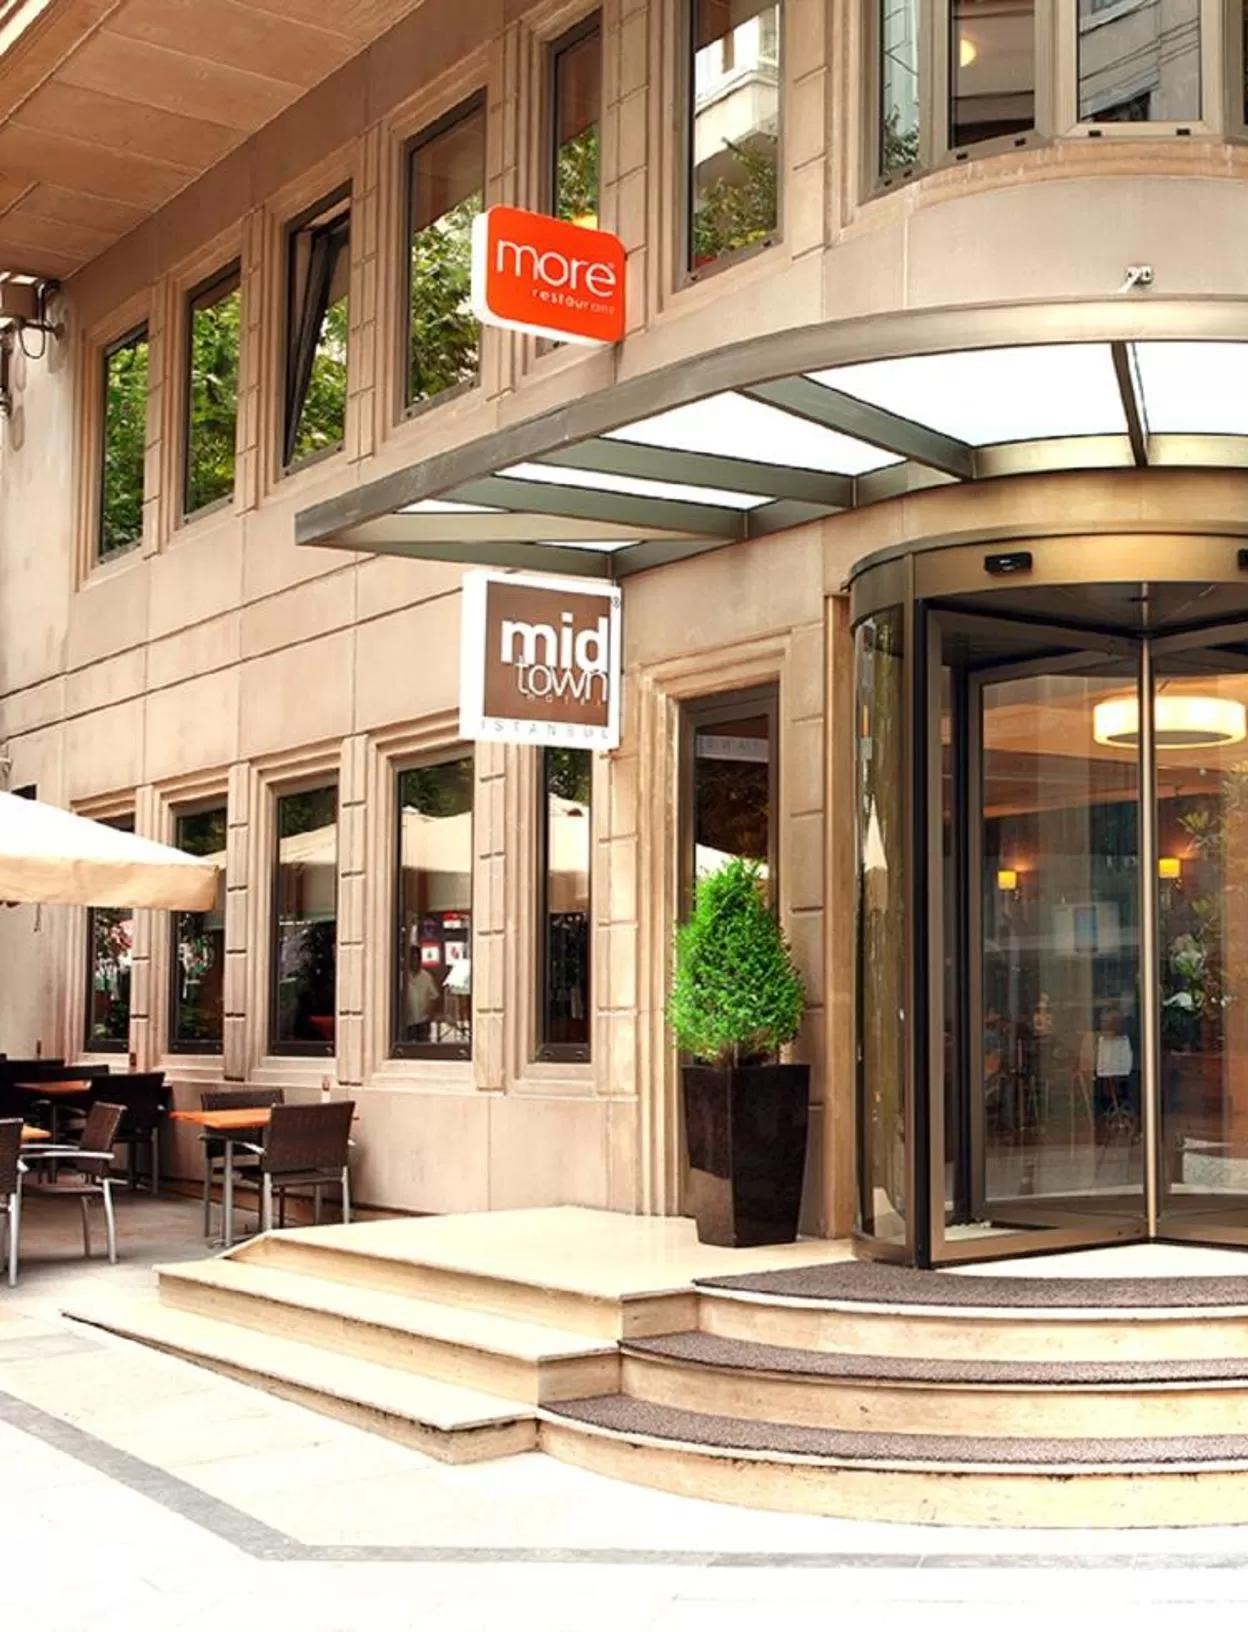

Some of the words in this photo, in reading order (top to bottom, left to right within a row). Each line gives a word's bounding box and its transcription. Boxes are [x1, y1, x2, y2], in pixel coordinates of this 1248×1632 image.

[496, 240, 616, 297] more
[501, 611, 609, 672] mid
[516, 653, 607, 701] town
